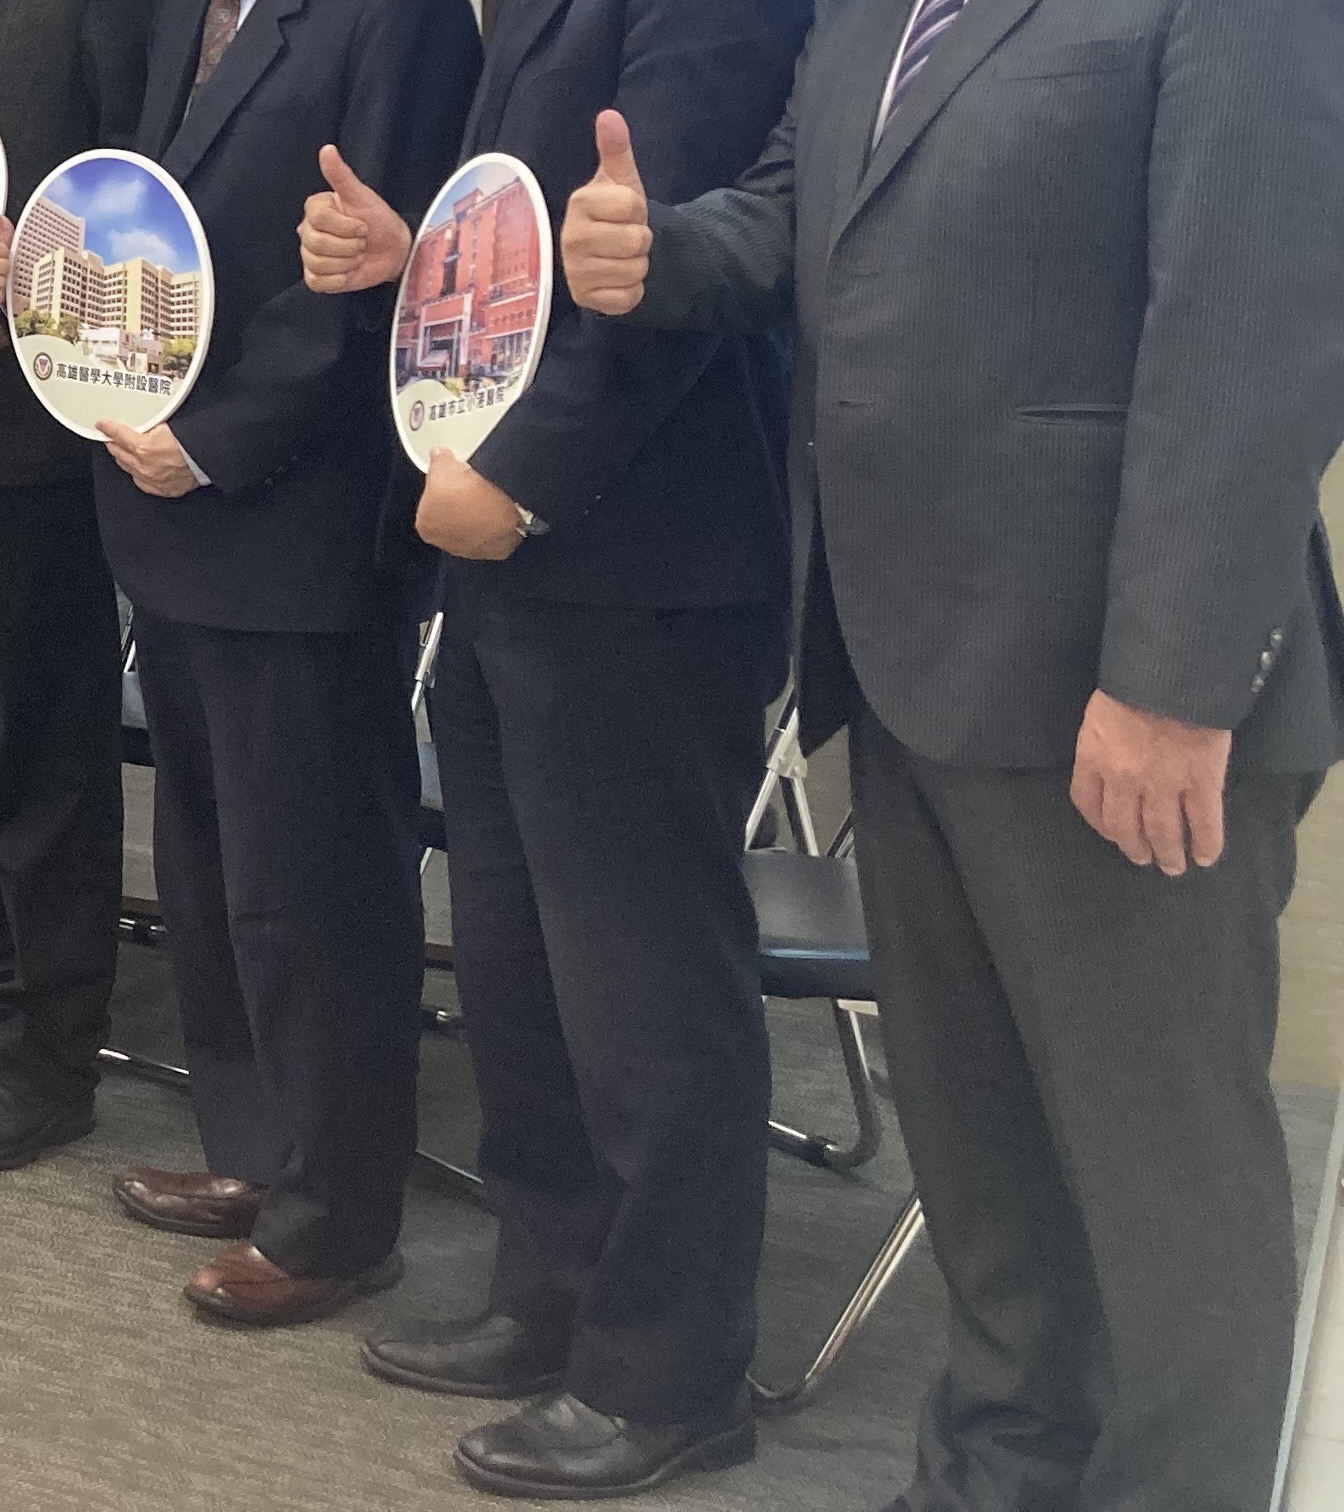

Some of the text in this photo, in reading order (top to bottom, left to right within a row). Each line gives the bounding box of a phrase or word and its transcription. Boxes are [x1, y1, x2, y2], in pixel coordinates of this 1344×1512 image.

[56, 363, 172, 396] 高雄醫學大學附設醫院
